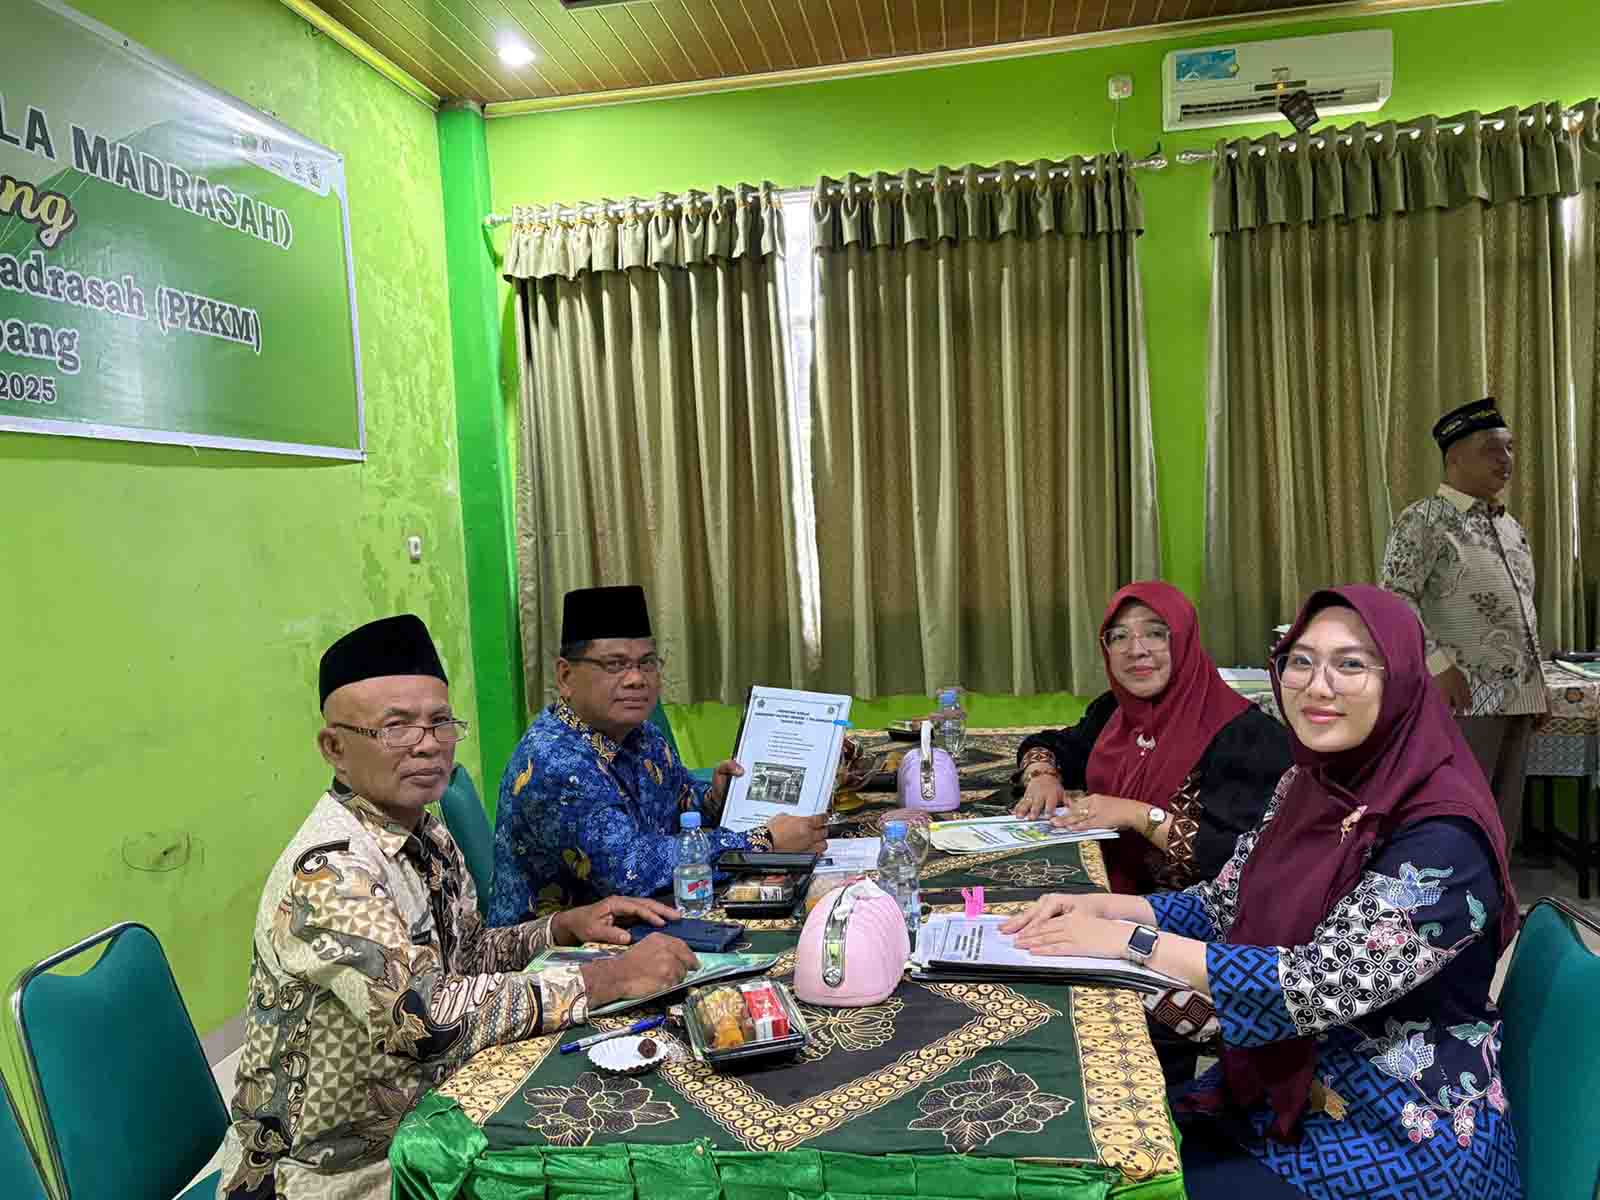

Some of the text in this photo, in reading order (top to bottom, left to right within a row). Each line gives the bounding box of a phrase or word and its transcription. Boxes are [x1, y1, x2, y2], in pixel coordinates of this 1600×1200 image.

[71, 123, 292, 249] MADRASAH)
[0, 251, 262, 353] adrasah (PKKM)
[0, 319, 80, 374] ang
[0, 371, 57, 403] 2025
